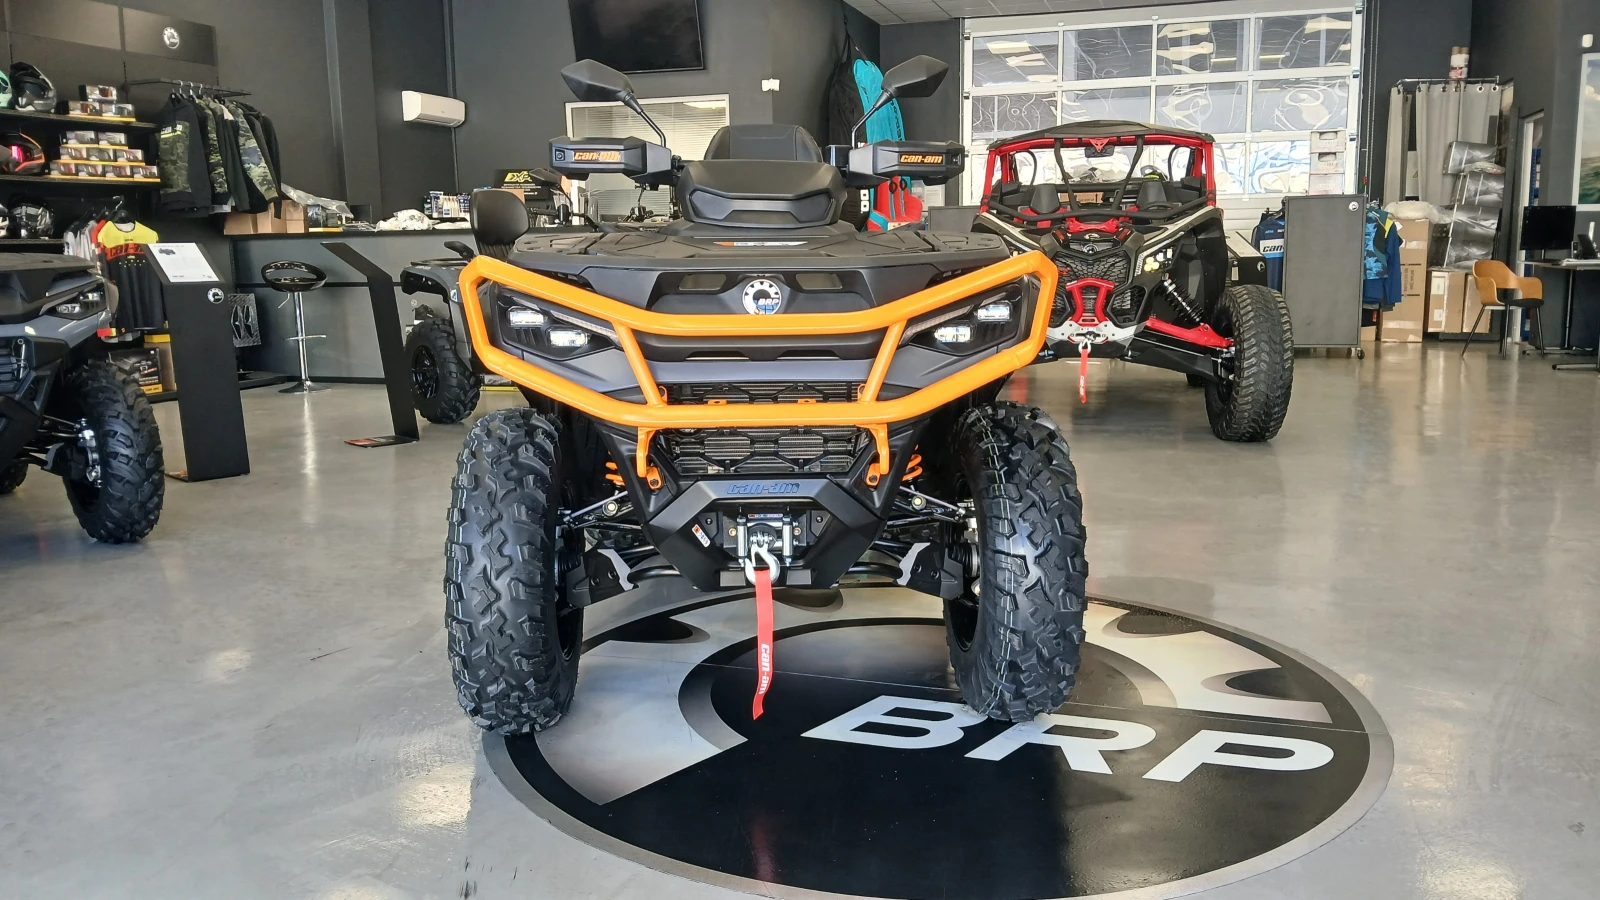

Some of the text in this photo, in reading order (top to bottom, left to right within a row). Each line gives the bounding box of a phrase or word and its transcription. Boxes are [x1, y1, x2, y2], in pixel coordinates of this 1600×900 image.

[574, 151, 620, 161] can-am
[900, 154, 943, 163] can-am
[757, 298, 780, 306] BRP
[727, 482, 800, 495] can-am
[758, 643, 770, 695] can-am
[801, 695, 1335, 782] BRP
